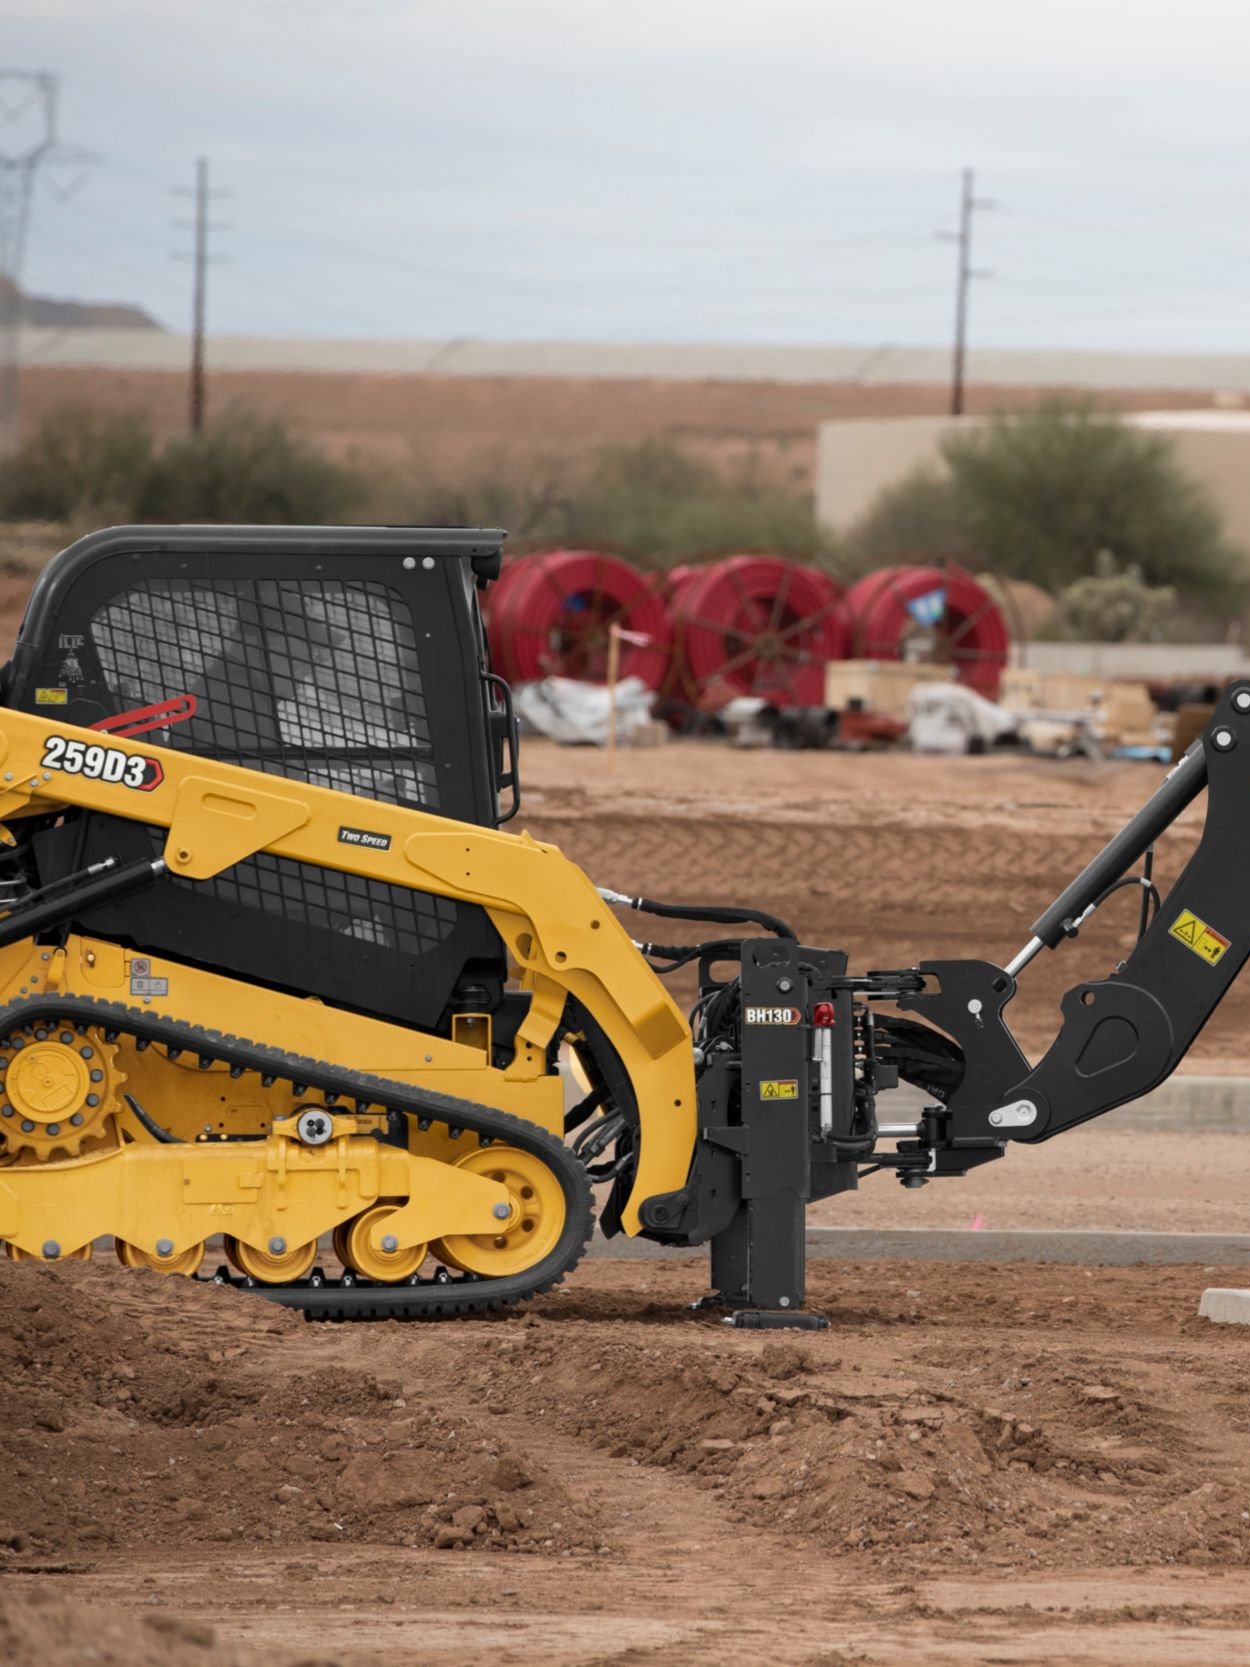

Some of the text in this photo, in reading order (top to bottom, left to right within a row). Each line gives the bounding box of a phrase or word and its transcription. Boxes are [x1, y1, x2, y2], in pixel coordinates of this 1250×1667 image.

[41, 736, 147, 788] 259D3
[341, 830, 388, 847] TWO SPEED
[746, 1008, 791, 1023] BH130
